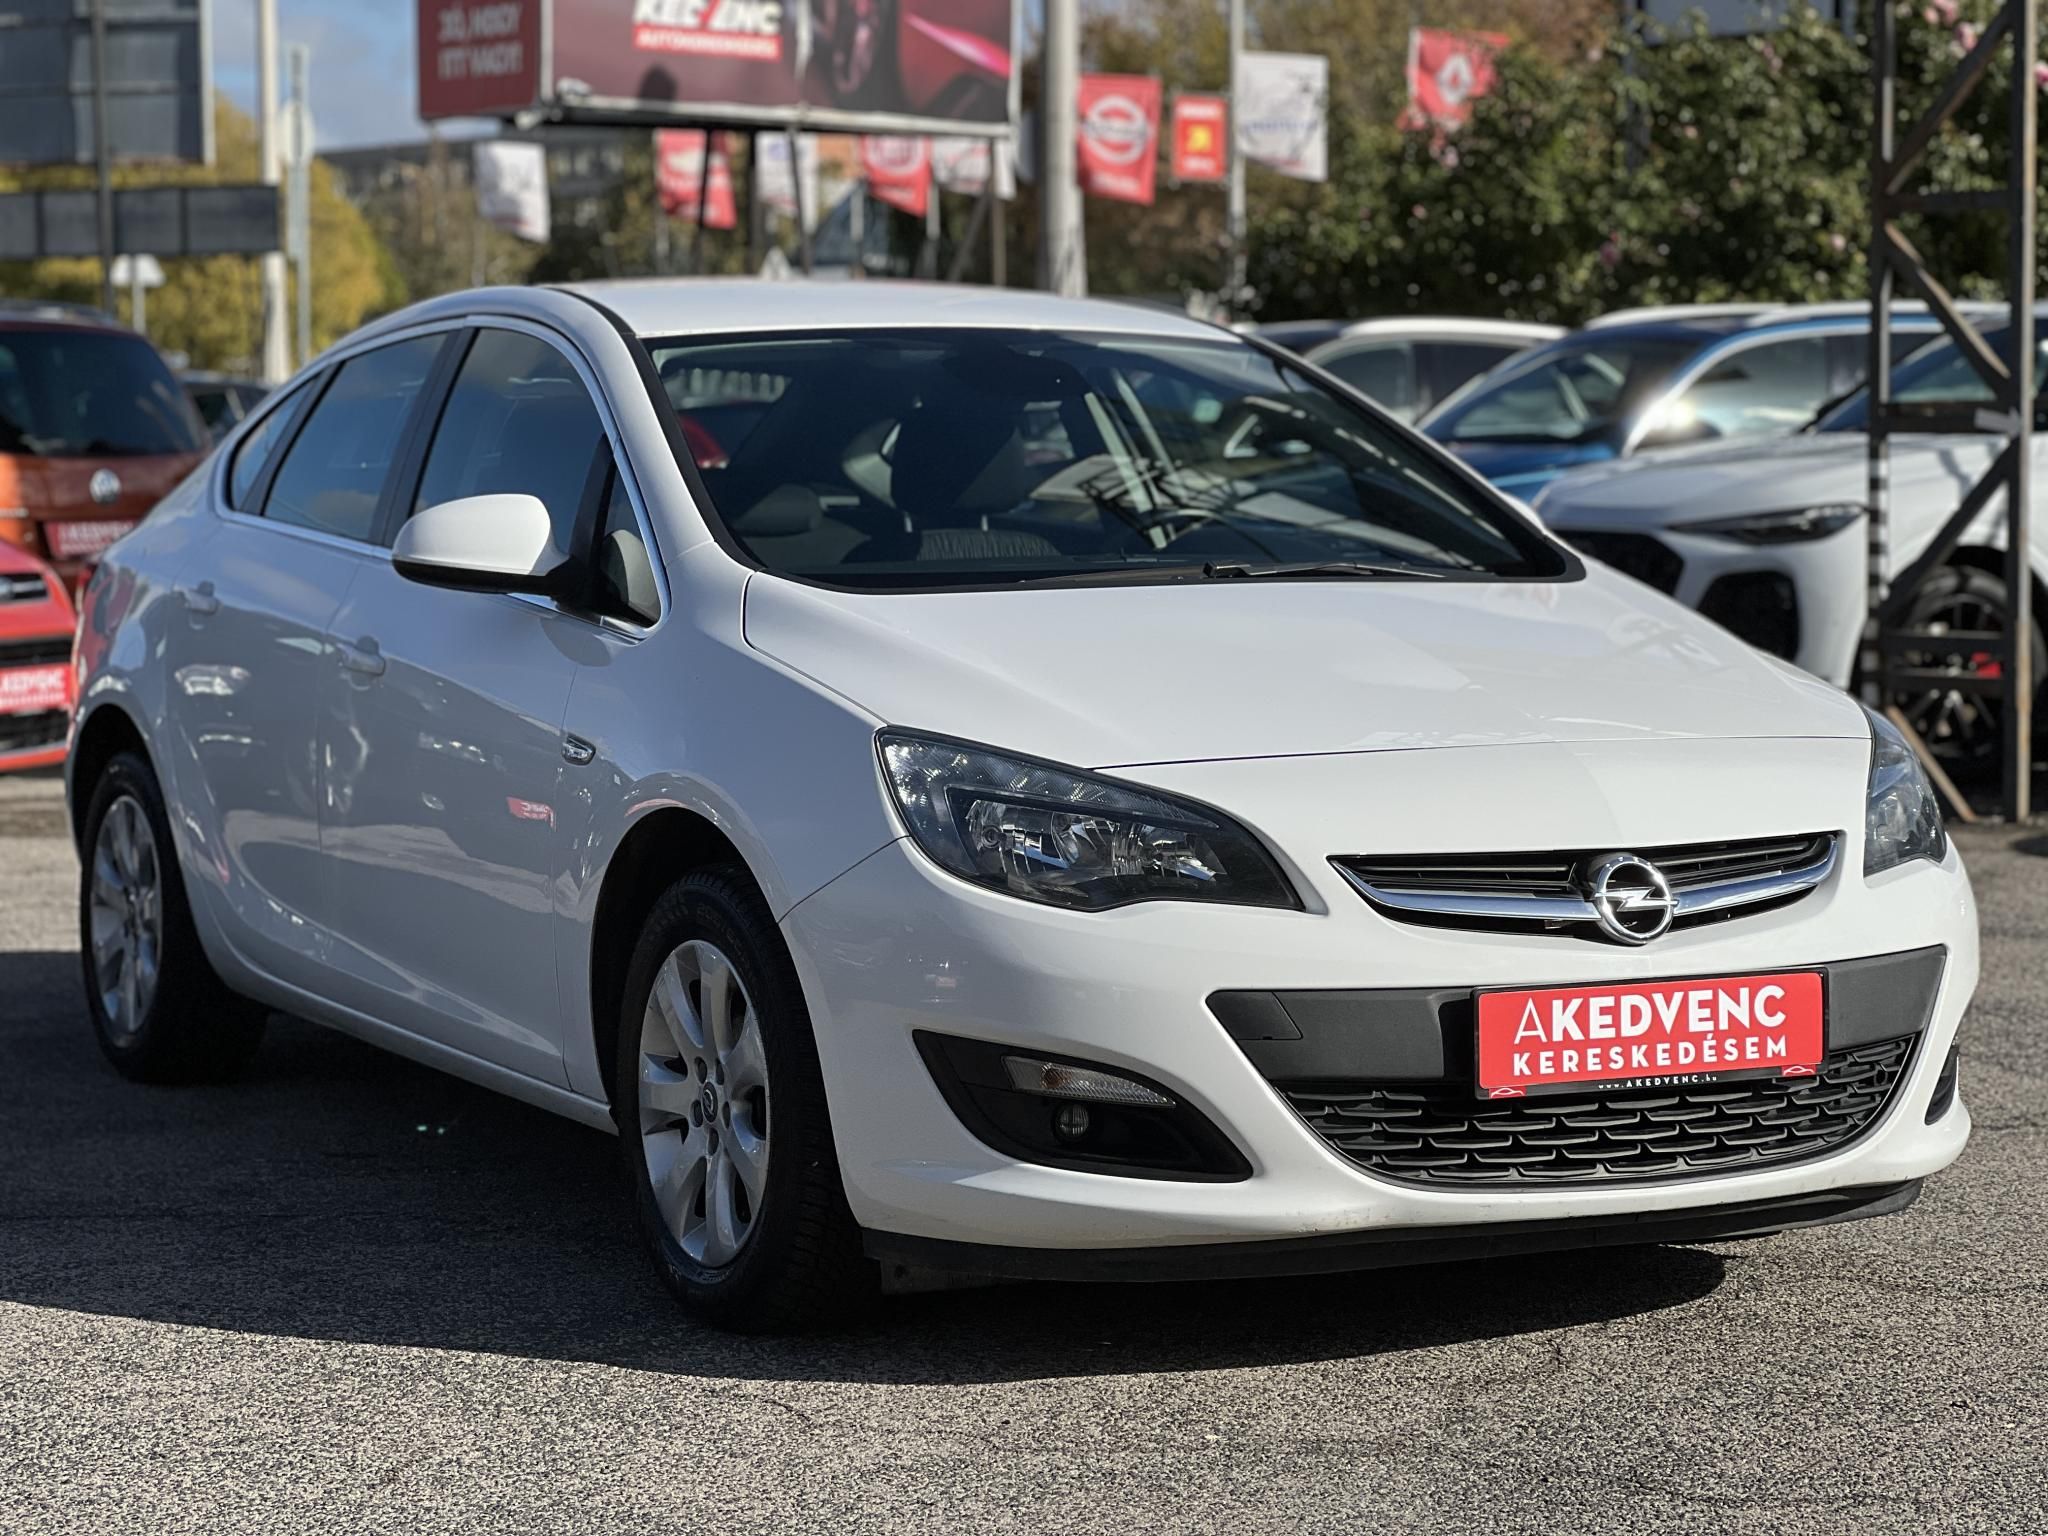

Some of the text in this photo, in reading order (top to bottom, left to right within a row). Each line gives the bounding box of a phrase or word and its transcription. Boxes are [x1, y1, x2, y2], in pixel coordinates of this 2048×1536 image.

[1513, 984, 1787, 1045] AKEDVENC
[1513, 1033, 1787, 1077] KERESKEDÉSEM
[1598, 1073, 1718, 1090] www.AKEDVENC.hu
